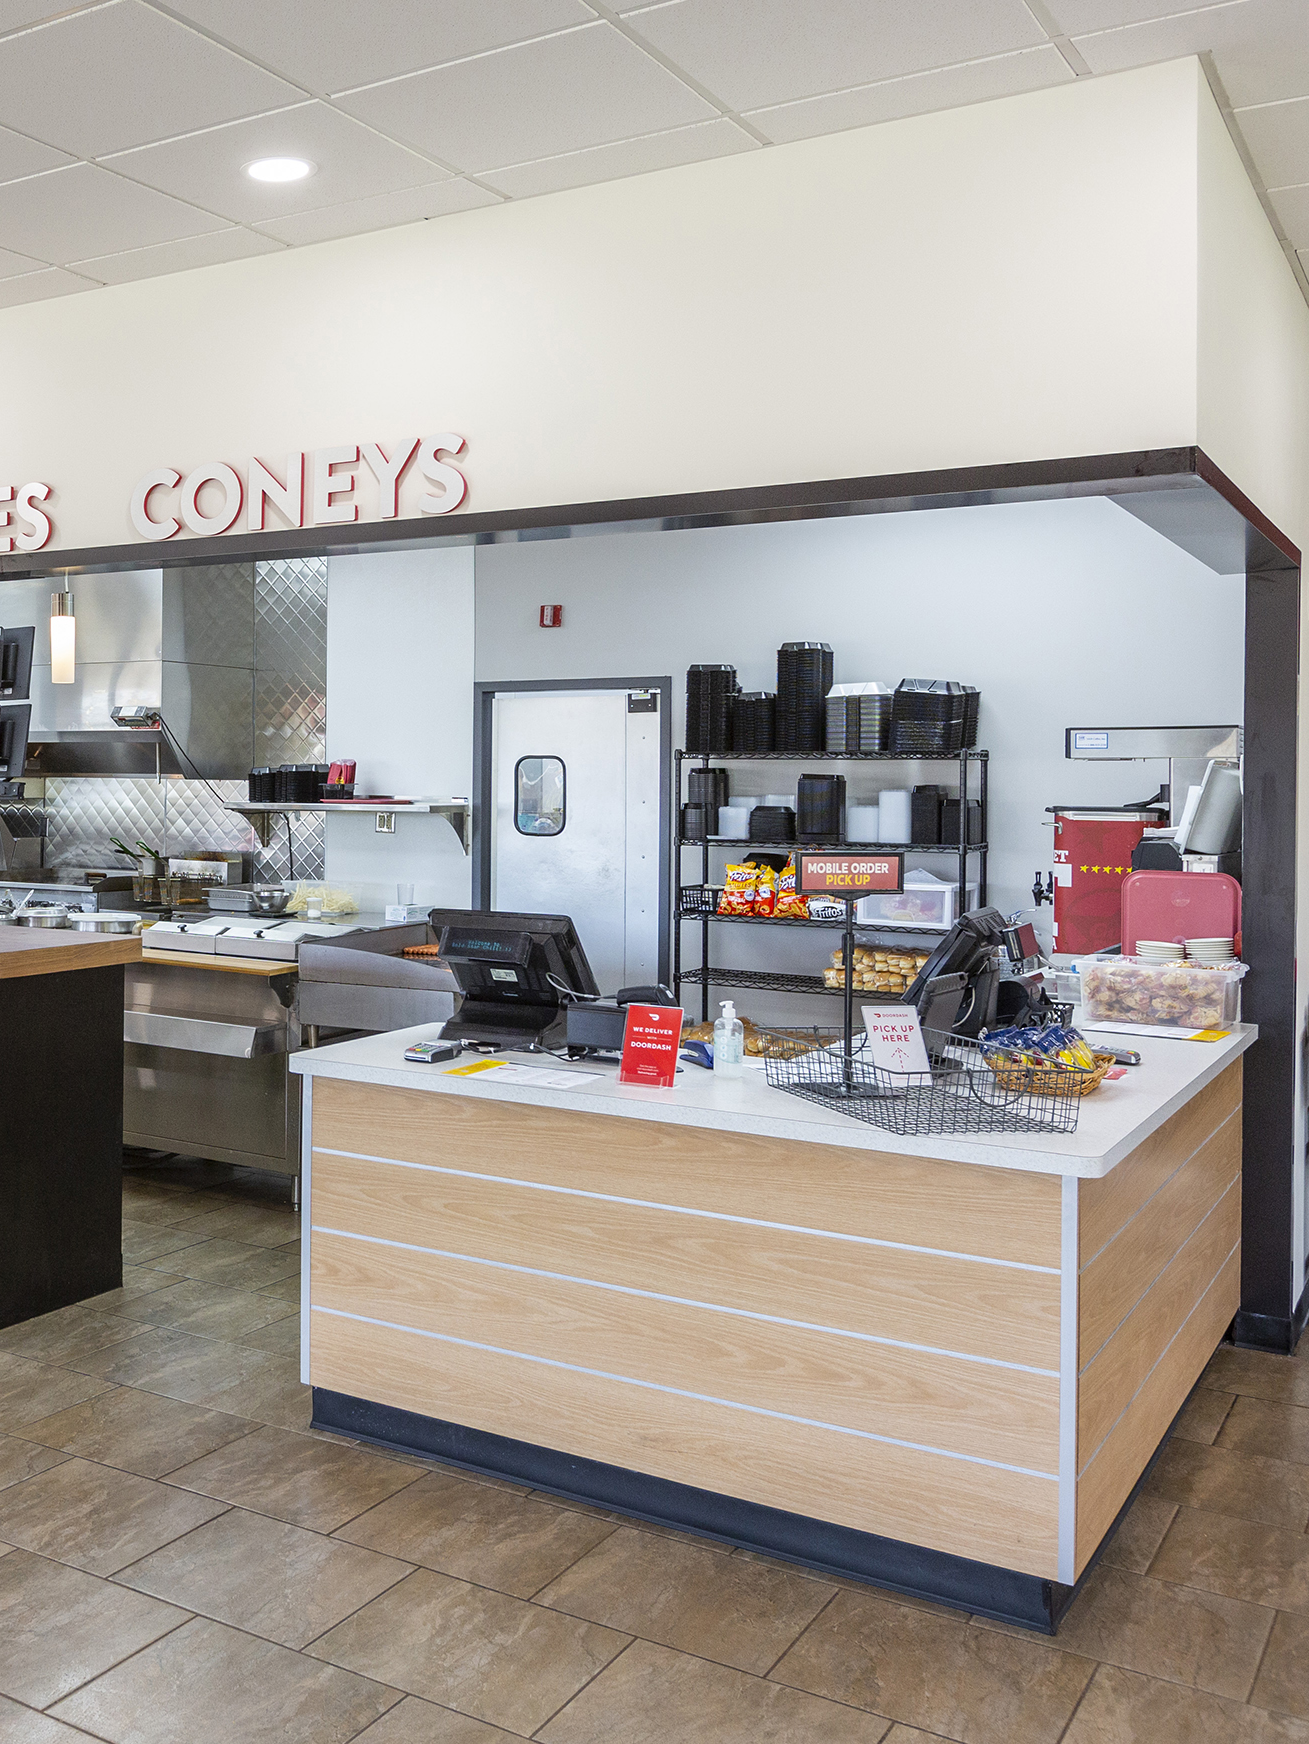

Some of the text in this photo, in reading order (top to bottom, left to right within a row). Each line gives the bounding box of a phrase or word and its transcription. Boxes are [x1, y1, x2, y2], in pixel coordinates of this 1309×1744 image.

[130, 432, 467, 541] CONEYS
[807, 863, 889, 874] MOBILE ORDER
[826, 874, 871, 885] PICK UP
[814, 907, 844, 919] Fritos
[644, 1027, 673, 1035] DELIVER
[872, 1025, 915, 1033] PICK UP
[881, 1034, 910, 1042] HERE
[630, 1041, 672, 1051] DOORDASH
